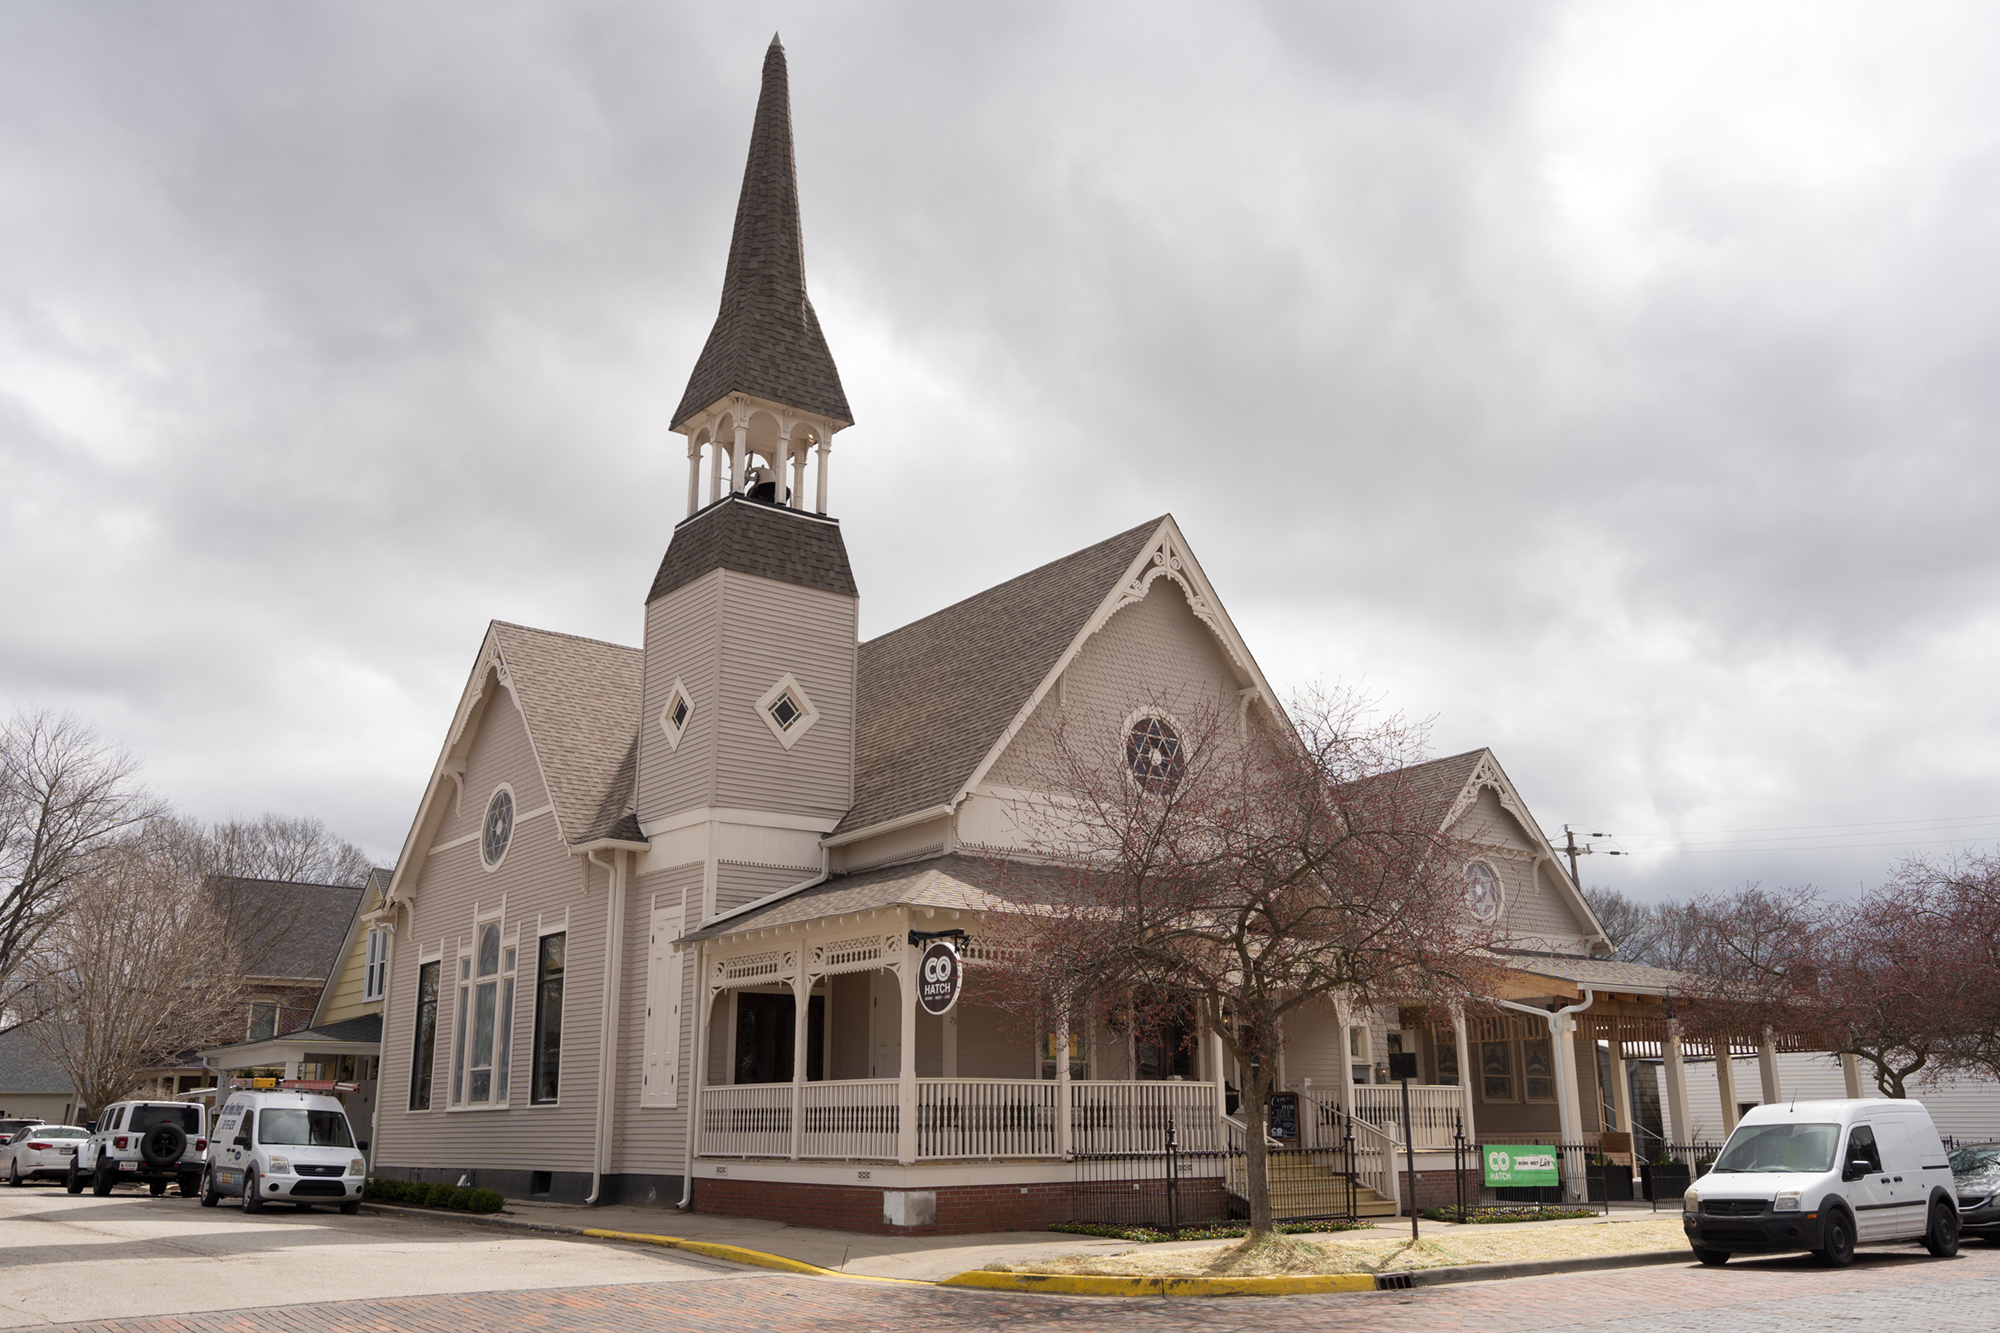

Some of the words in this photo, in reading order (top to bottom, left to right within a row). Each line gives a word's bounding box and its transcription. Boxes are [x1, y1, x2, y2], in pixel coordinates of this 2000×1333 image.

[925, 956, 951, 982] CO
[925, 983, 950, 995] HATCH
[1489, 1152, 1510, 1171] CO
[1490, 1172, 1511, 1180] HATCH
